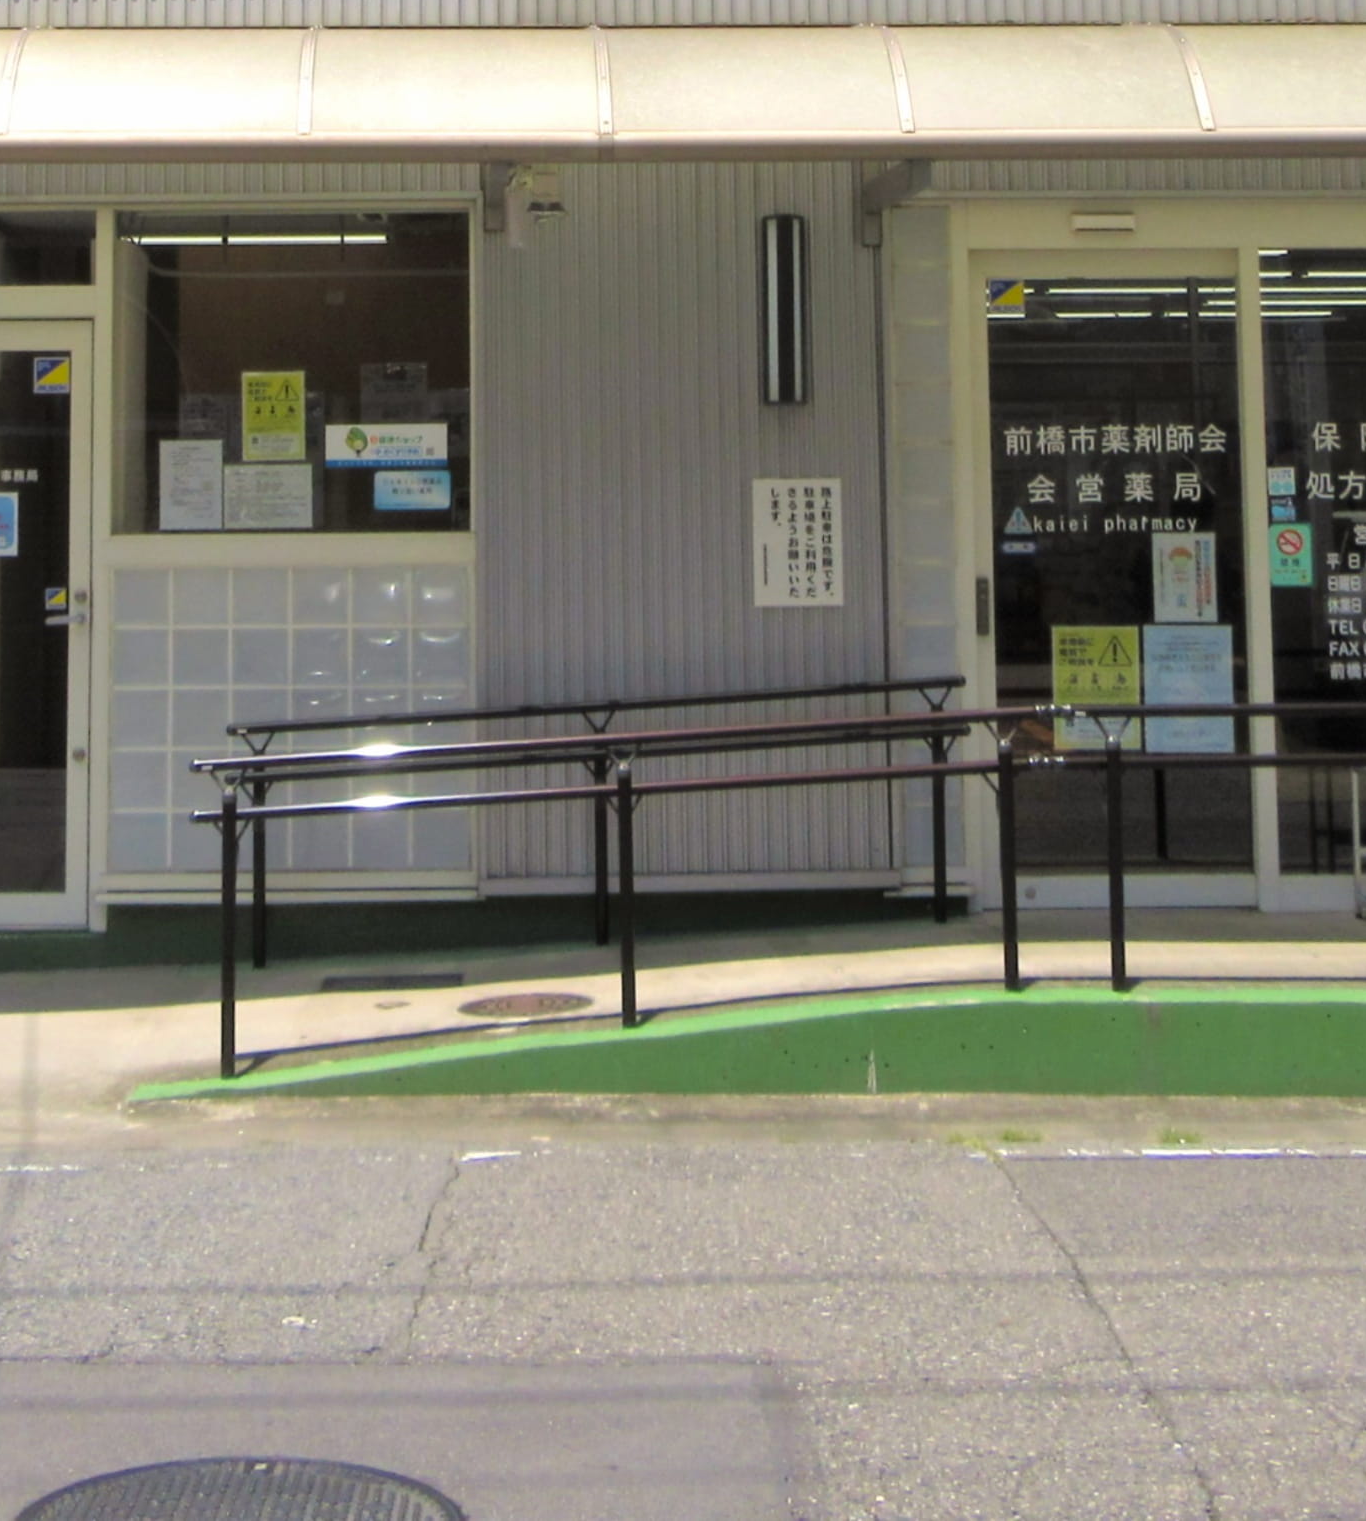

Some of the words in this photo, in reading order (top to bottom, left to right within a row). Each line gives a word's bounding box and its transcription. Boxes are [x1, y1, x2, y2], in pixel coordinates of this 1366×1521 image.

[1003, 423, 1227, 456] 前橋市薬剤師会
[1026, 472, 1203, 503] 会営薬局
[1033, 515, 1089, 532] kaiei
[1104, 515, 1198, 535] pharmacy
[1328, 619, 1359, 635] TEL
[1329, 641, 1361, 657] FAX
